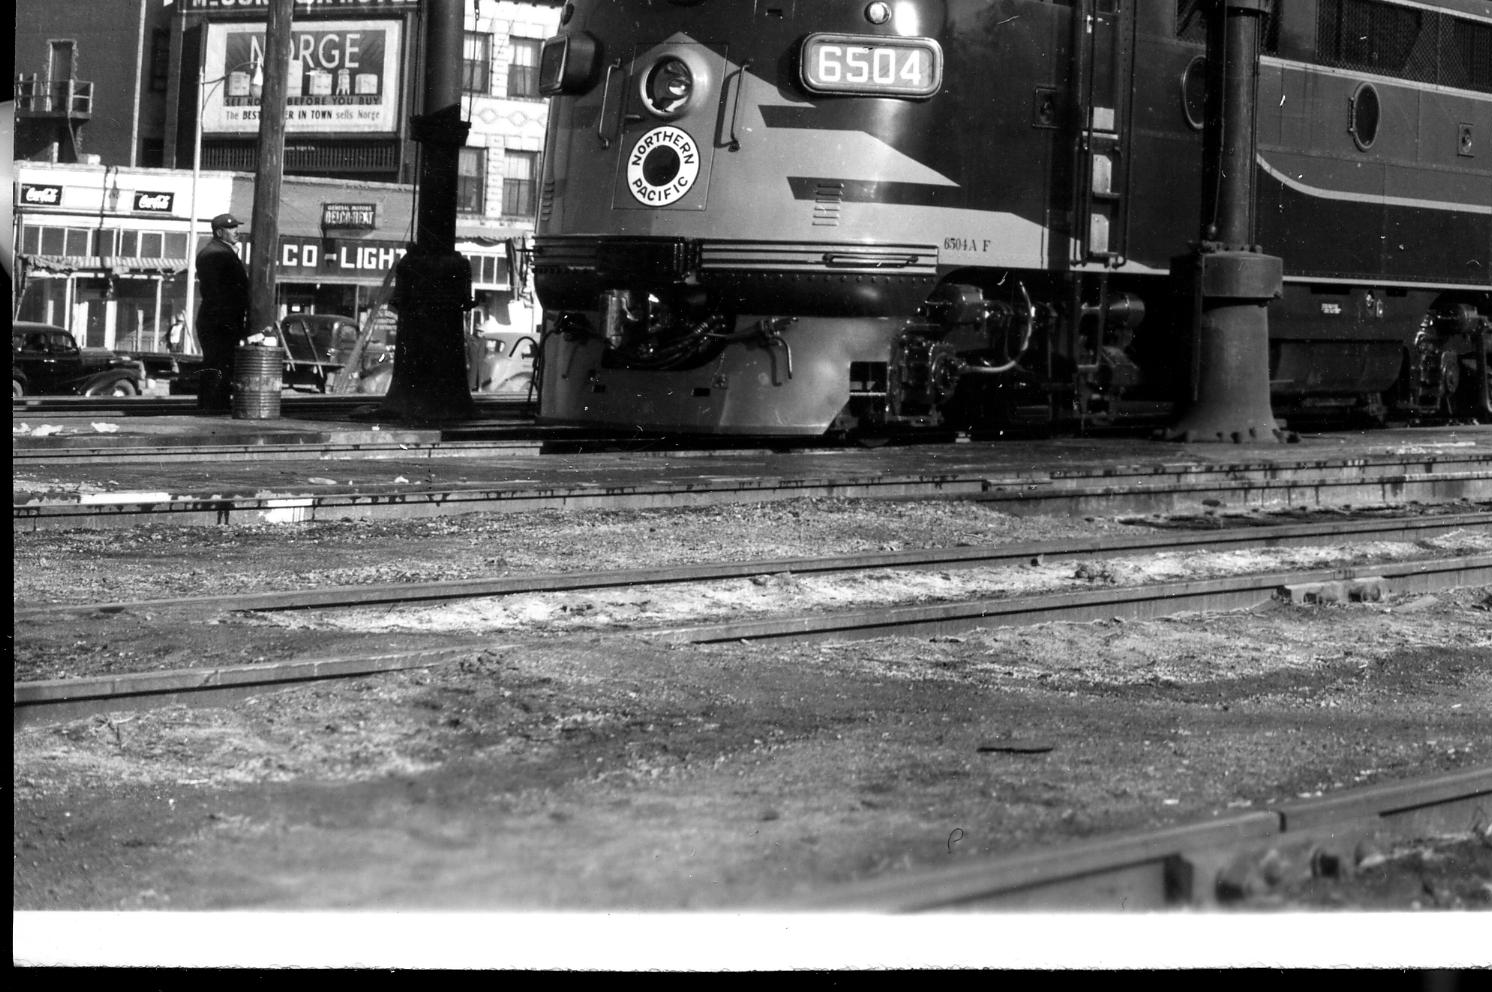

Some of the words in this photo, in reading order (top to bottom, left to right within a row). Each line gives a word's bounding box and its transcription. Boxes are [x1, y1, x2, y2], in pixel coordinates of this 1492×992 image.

[250, 33, 361, 69] NRGE
[818, 45, 921, 86] 6504
[287, 96, 327, 106] BEFORE
[332, 96, 353, 105] YOU
[359, 96, 379, 105] BUY
[311, 110, 333, 119] TOWN
[632, 131, 694, 166] NORTHERN
[632, 176, 688, 201] PACIFIC
